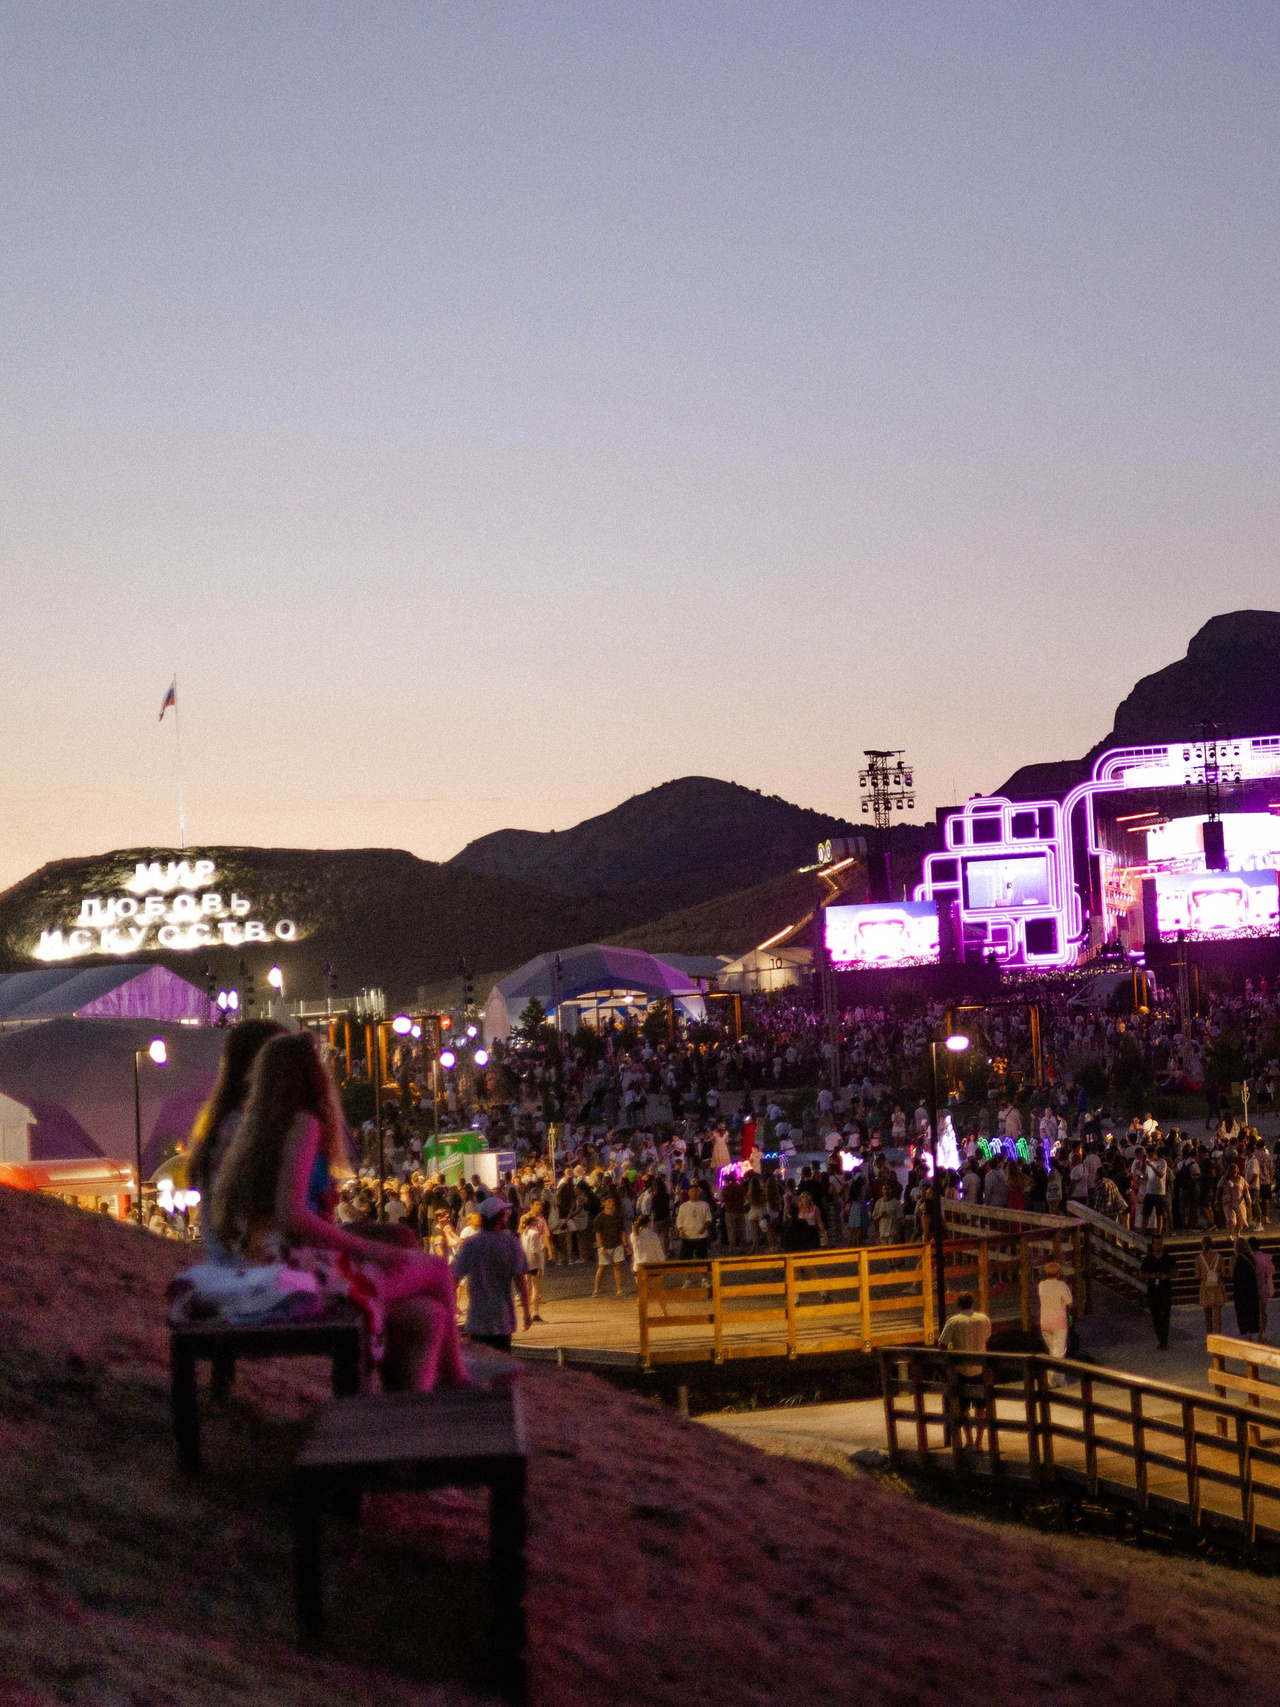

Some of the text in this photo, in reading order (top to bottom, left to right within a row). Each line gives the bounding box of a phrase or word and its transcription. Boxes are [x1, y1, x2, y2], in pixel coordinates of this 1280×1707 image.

[134, 860, 216, 889] МИР
[78, 893, 250, 922] ЛЮБОВЬ
[40, 919, 296, 951] ИСКУССТВО
[770, 957, 782, 969] 10
